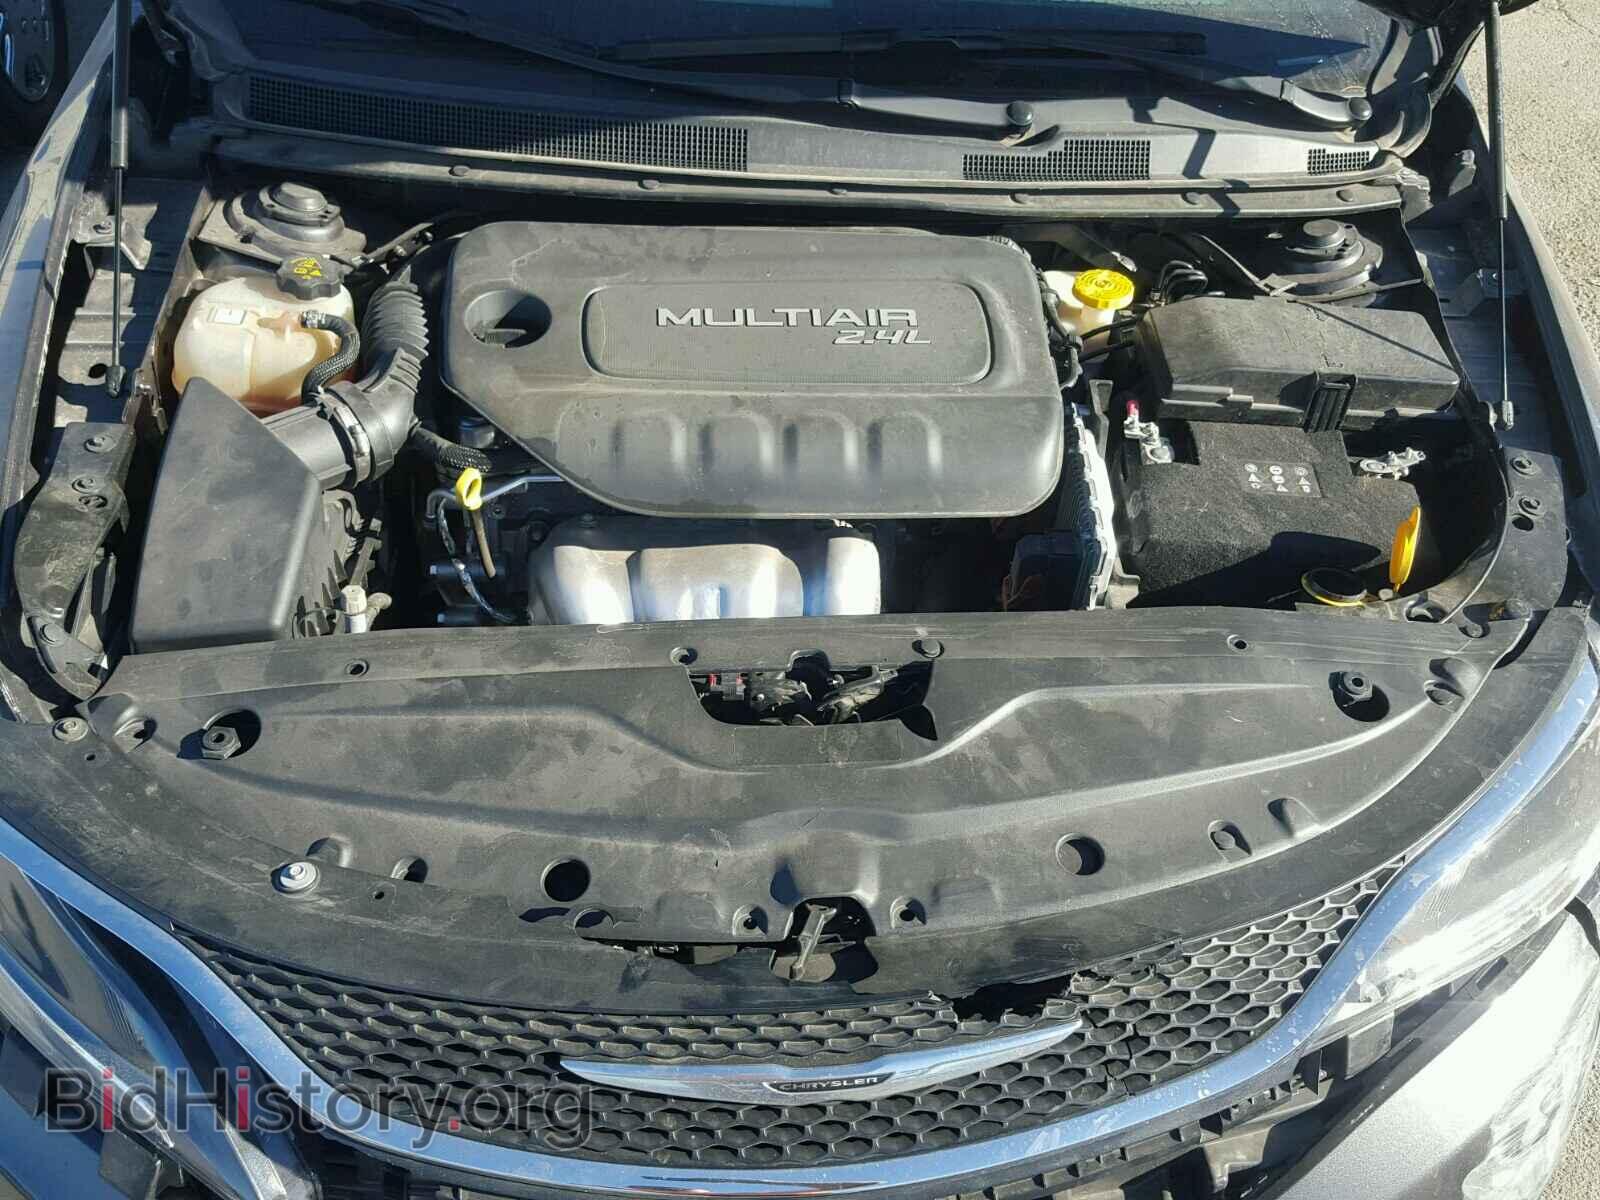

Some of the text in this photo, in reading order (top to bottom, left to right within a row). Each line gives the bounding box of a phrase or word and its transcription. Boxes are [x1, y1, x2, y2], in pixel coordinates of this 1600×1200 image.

[656, 308, 918, 327] MULTIAIR
[833, 329, 931, 344] 2.4L
[780, 1077, 878, 1091] CHRYSLER
